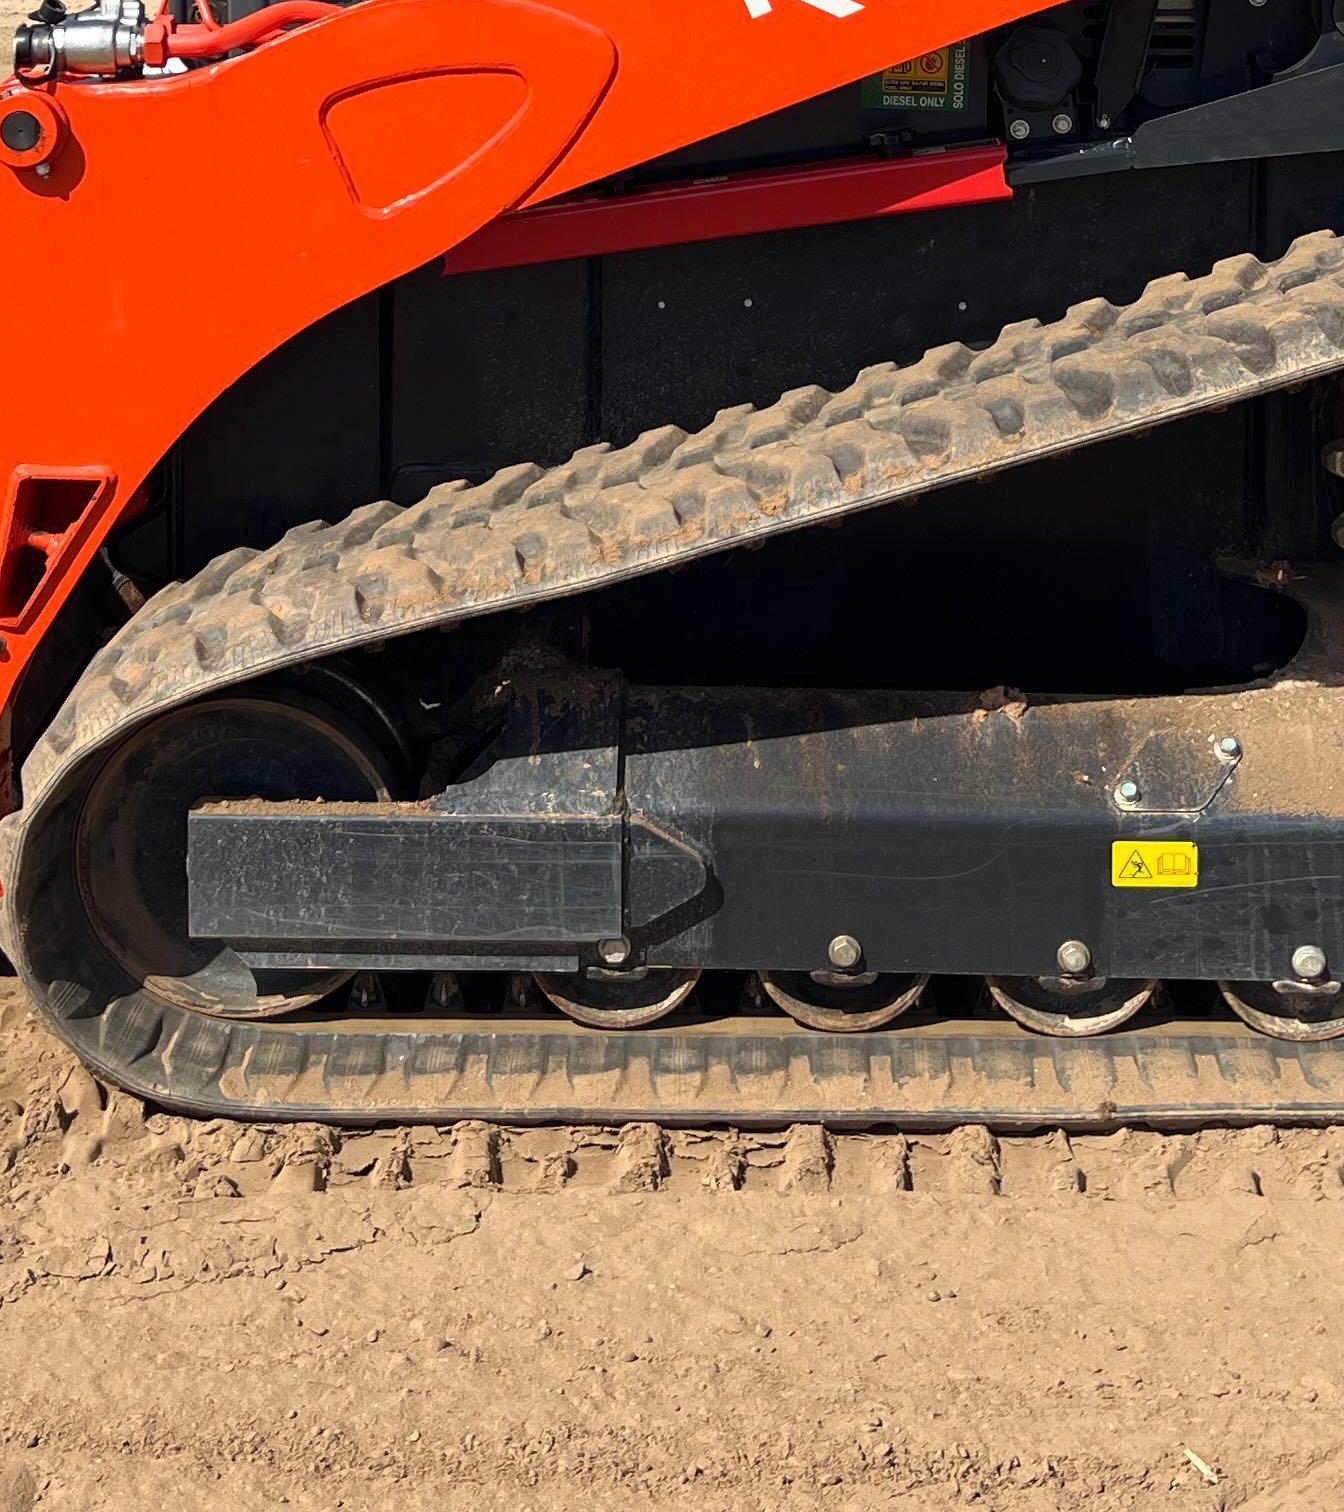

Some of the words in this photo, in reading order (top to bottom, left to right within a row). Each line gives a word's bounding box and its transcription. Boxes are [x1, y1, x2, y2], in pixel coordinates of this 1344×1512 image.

[954, 46, 966, 81] DIESEL
[882, 95, 917, 107] DIESEL
[919, 96, 945, 108] ONLY
[952, 82, 964, 109] SOLO
